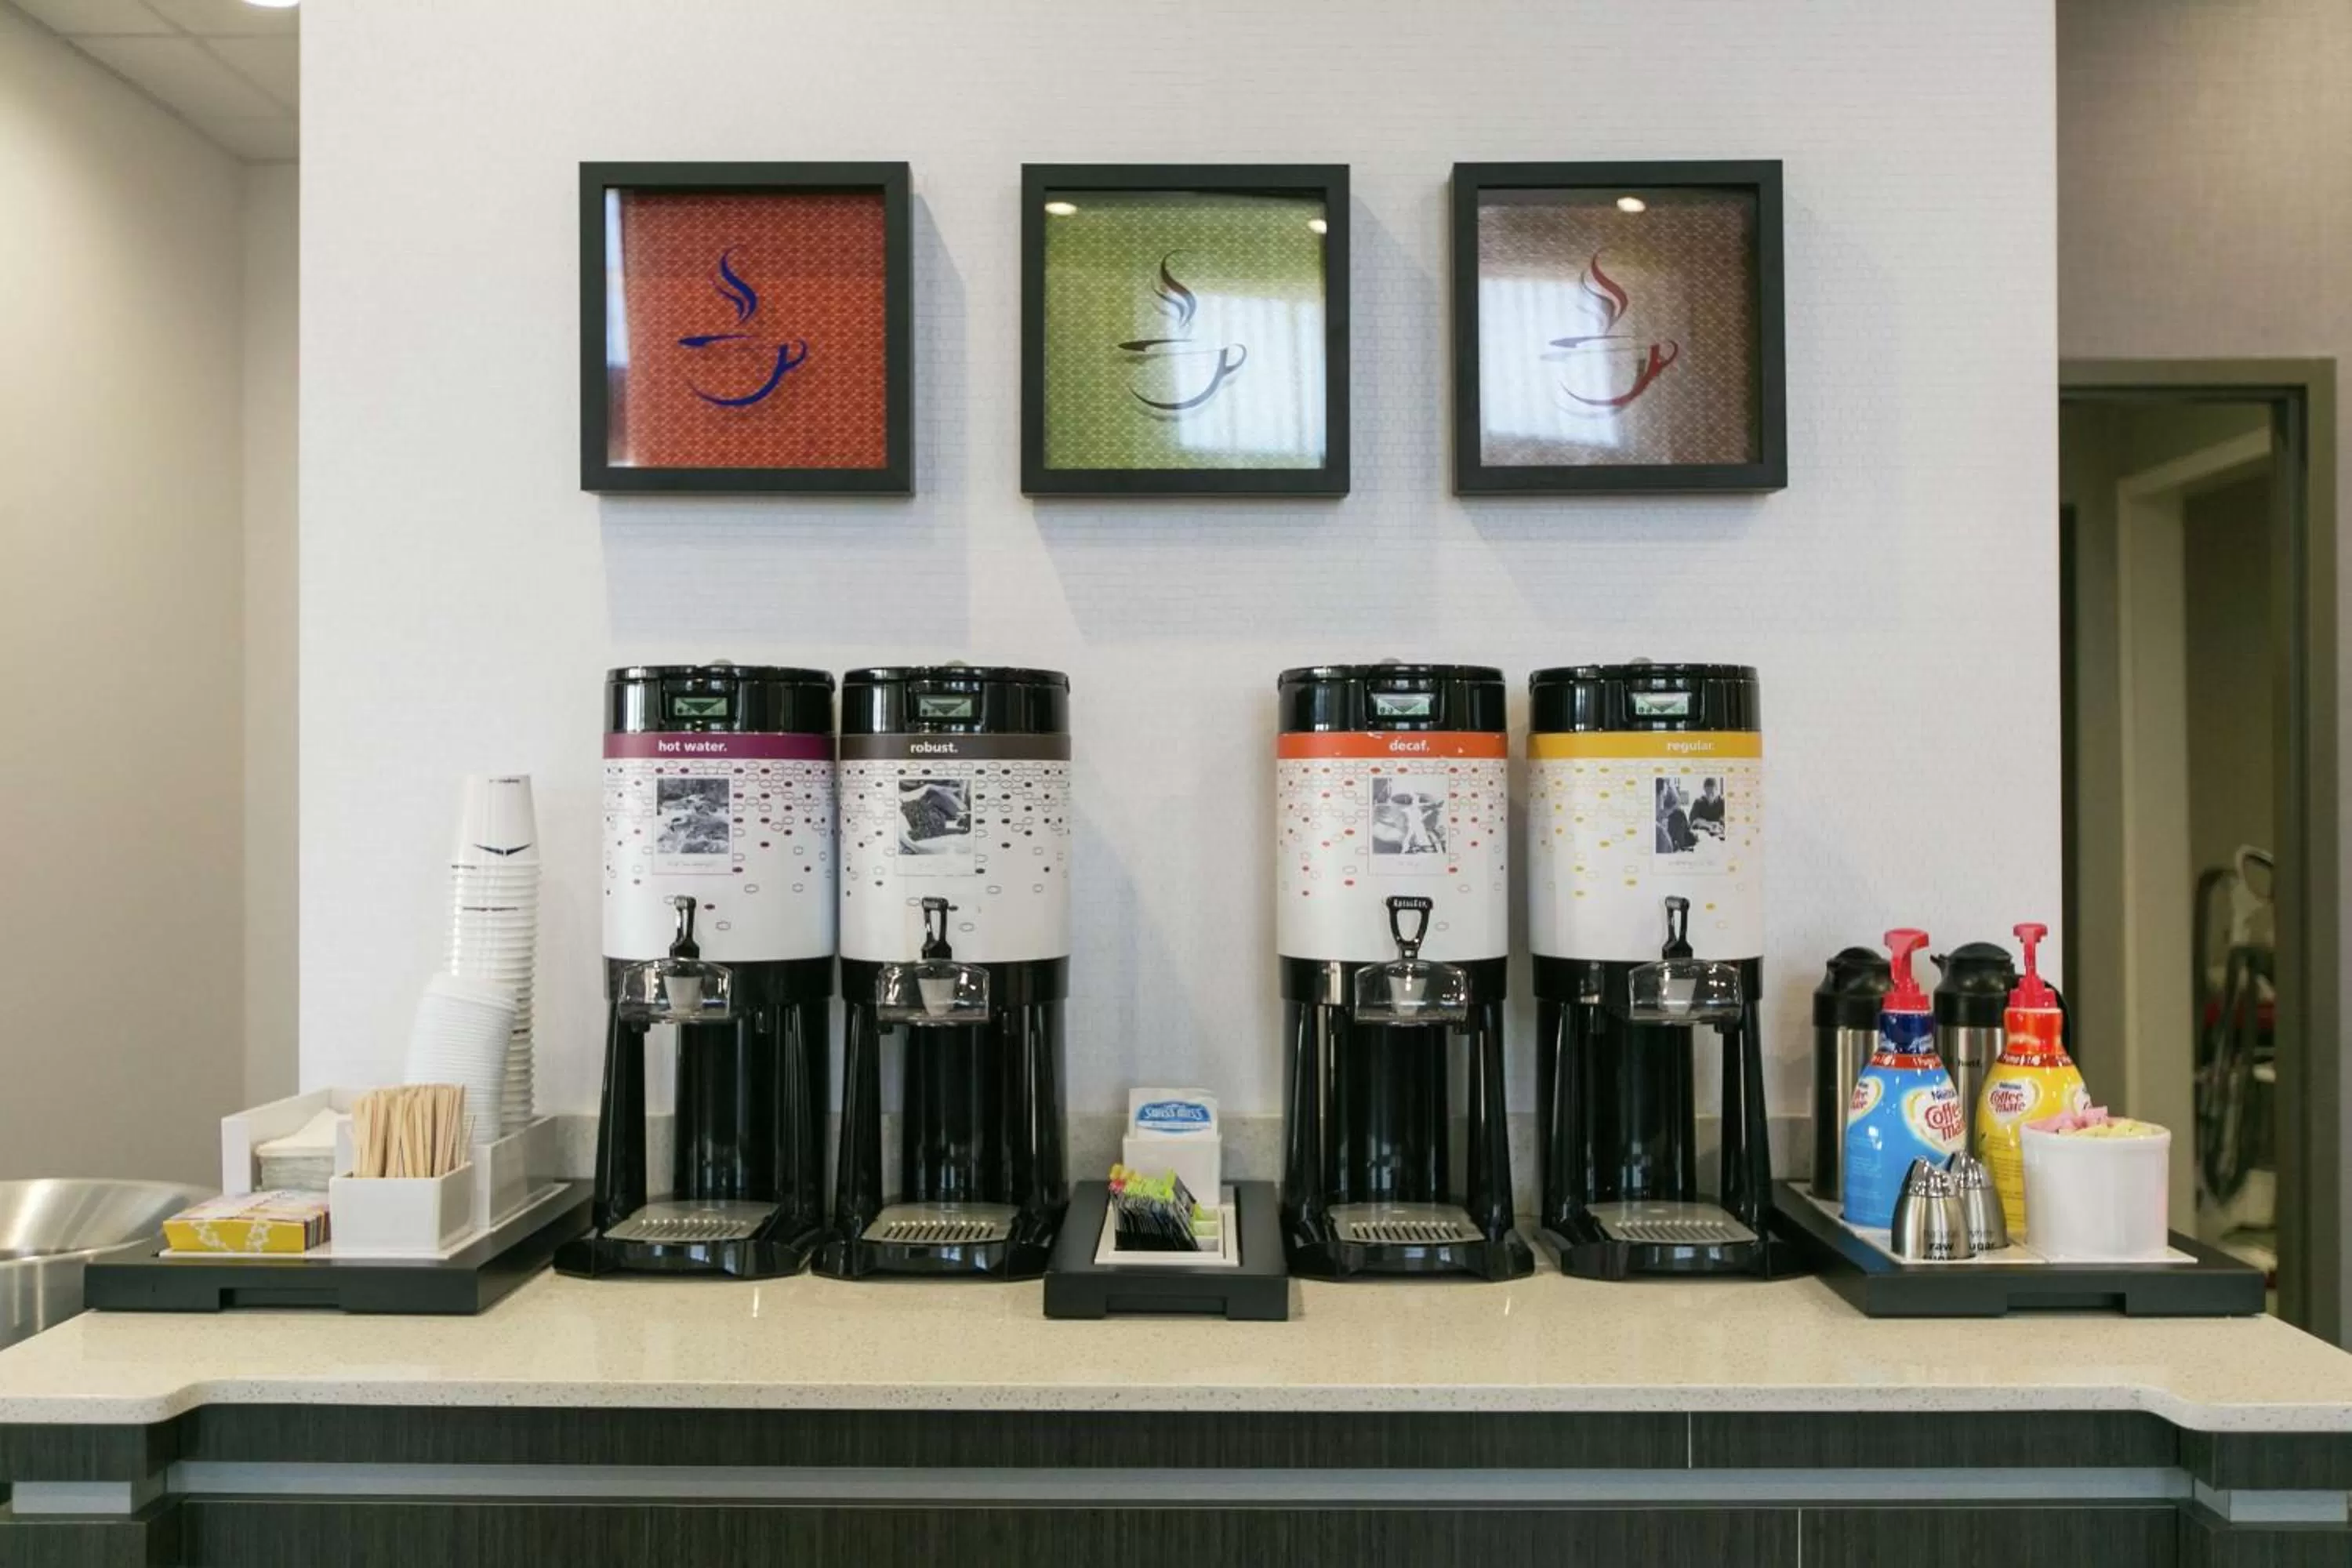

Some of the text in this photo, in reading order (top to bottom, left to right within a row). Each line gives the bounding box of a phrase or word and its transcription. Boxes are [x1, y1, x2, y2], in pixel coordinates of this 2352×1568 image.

[659, 740, 728, 752] hot water.
[910, 742, 959, 753] robust.
[1389, 739, 1430, 752] decaf.
[1929, 1243, 1954, 1251] raw
[1968, 1242, 1995, 1252] ugar
